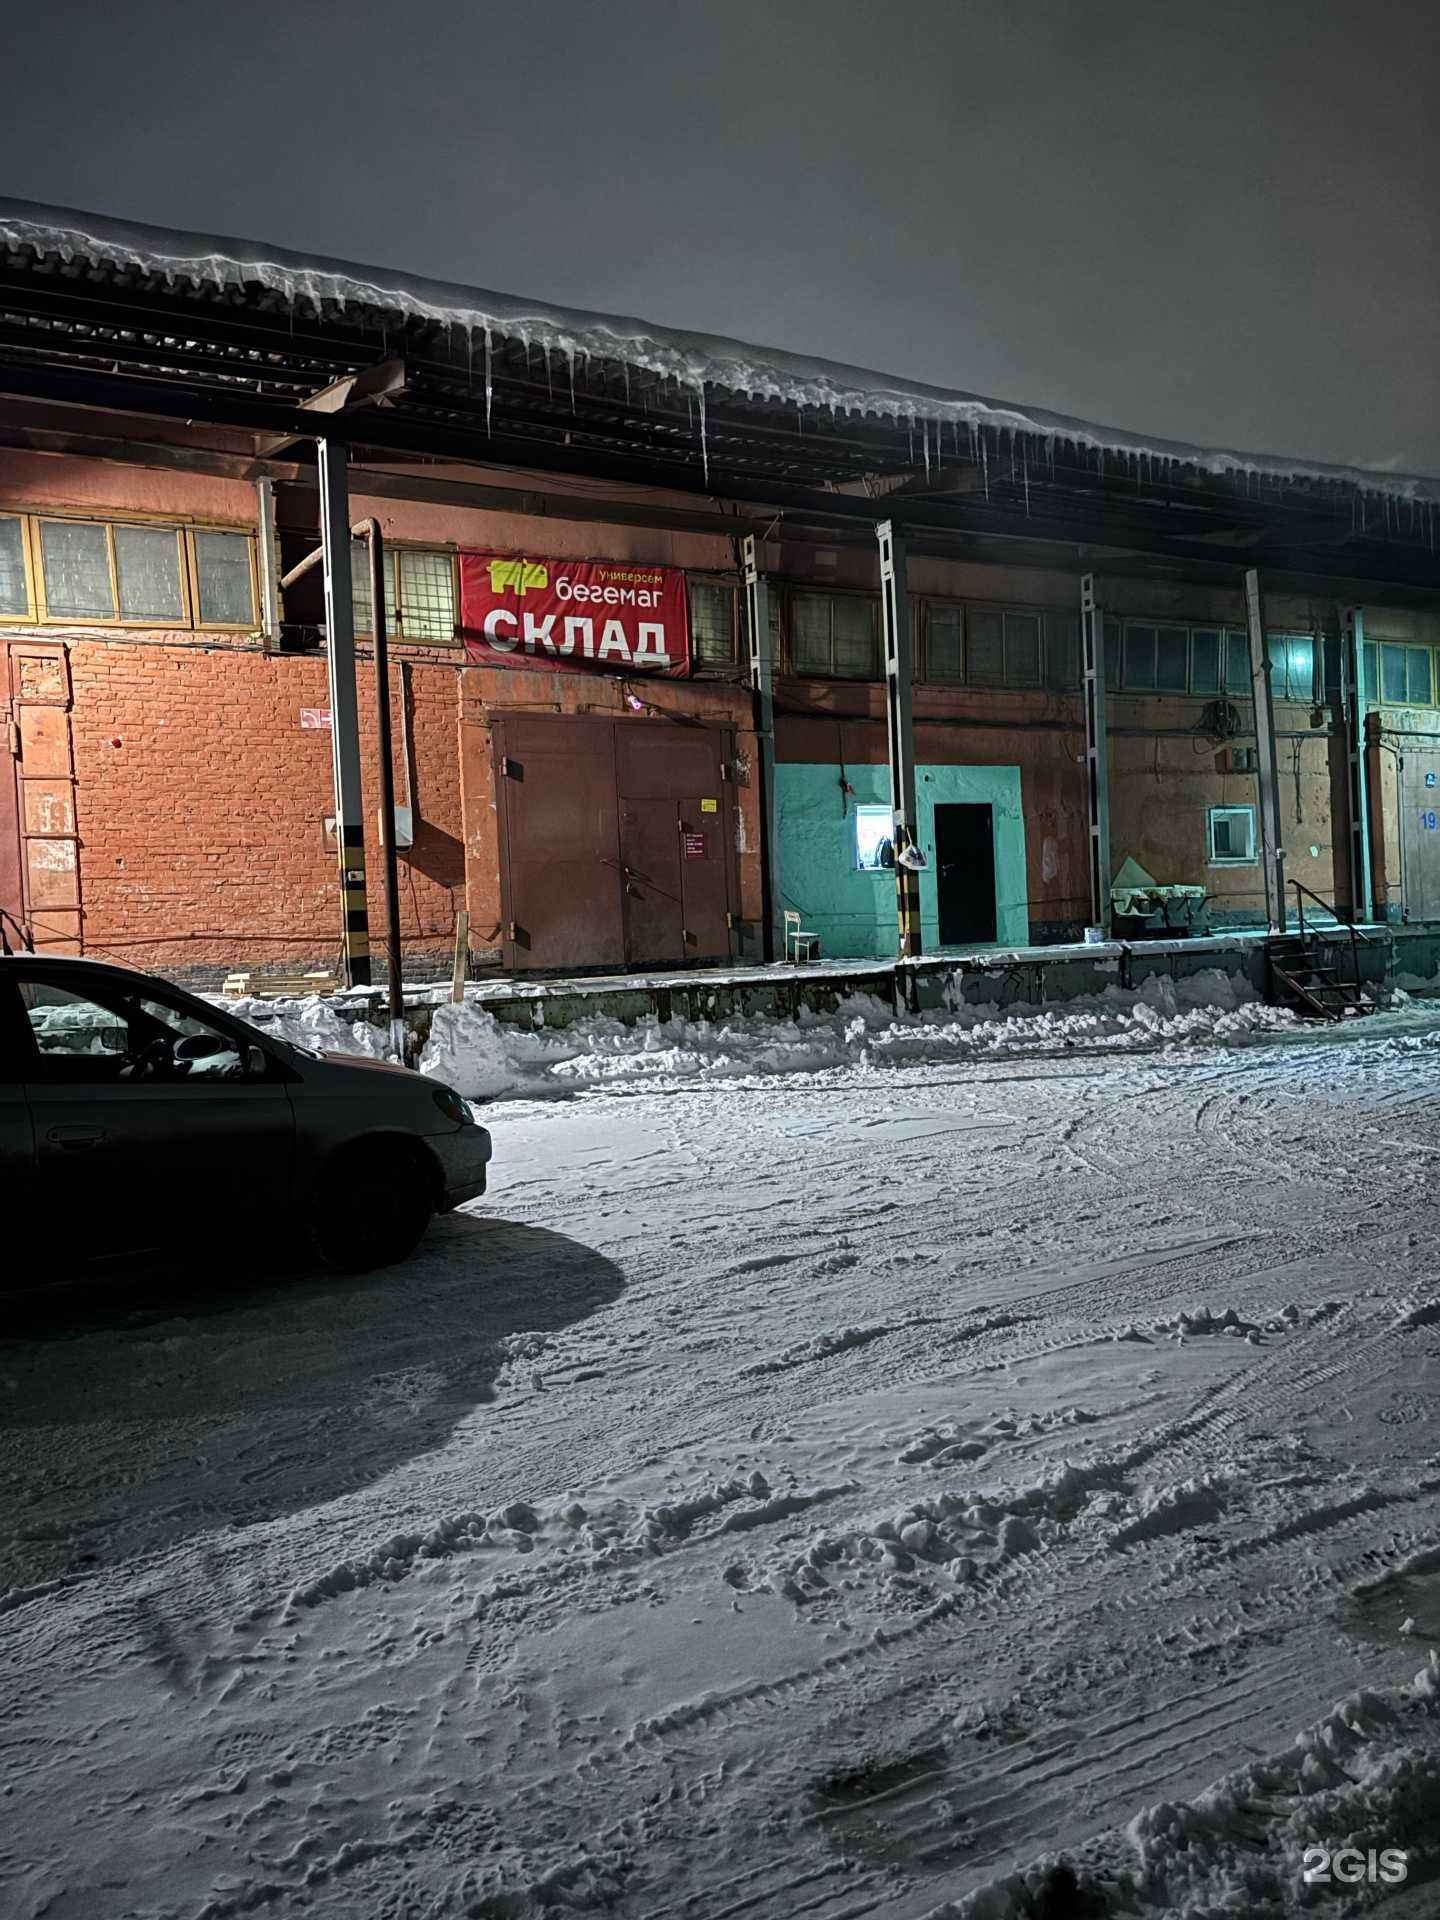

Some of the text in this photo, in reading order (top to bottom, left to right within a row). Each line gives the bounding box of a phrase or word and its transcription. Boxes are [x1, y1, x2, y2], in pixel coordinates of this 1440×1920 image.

[599, 569, 663, 585] универсам
[555, 576, 663, 608] бегемаг
[484, 609, 670, 671] СКЛАД
[1420, 811, 1437, 829] 19
